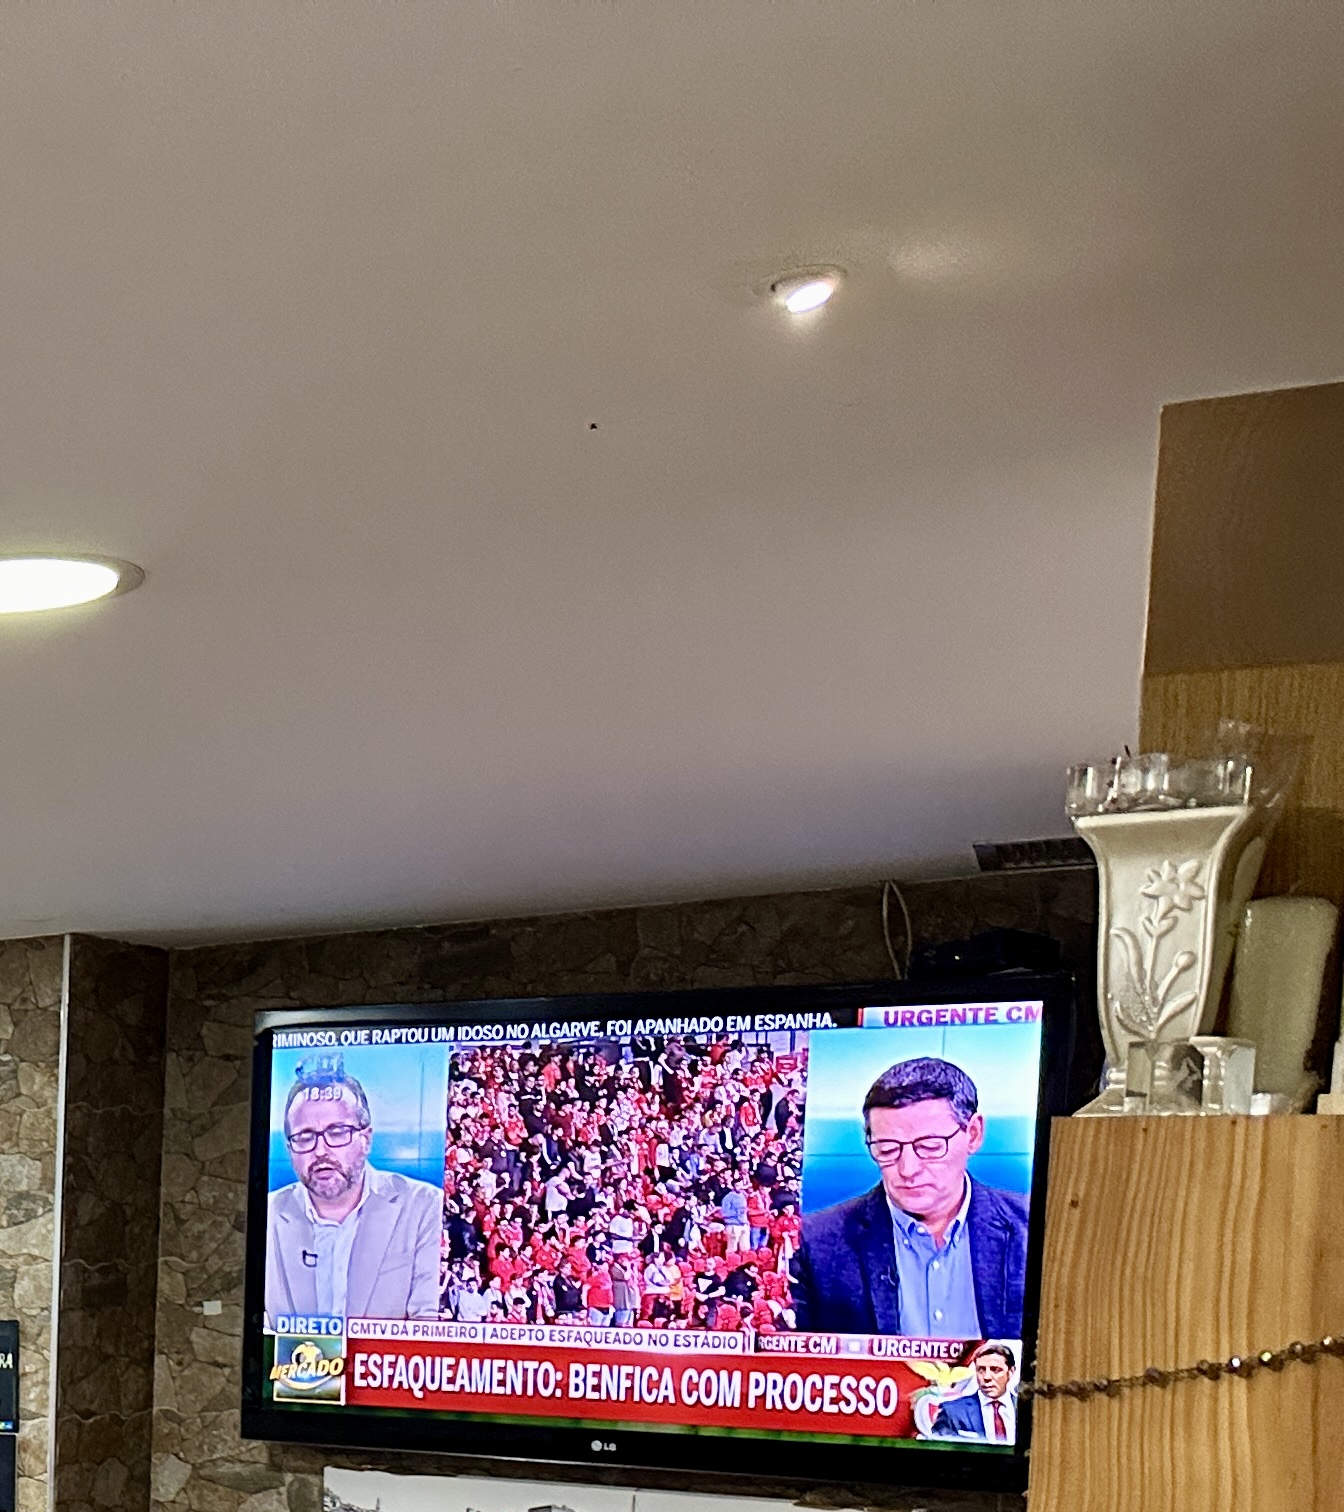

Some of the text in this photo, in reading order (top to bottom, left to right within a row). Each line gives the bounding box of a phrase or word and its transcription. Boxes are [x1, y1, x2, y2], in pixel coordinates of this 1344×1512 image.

[884, 1004, 1041, 1027] URGENTE CM
[341, 1030, 370, 1046] QUE
[372, 1027, 430, 1045] RAPTOU
[432, 1026, 455, 1042] UM
[458, 1024, 504, 1041] IDOSO
[506, 1023, 530, 1040] NO
[531, 1020, 603, 1039] ALGARVE,
[607, 1018, 633, 1036] FOI
[635, 1015, 725, 1034] APANHADO
[726, 1014, 751, 1032] EM
[754, 1012, 837, 1031] ESPANHA.
[303, 1087, 343, 1101] 18:39
[277, 1316, 342, 1335] DIRETO
[351, 1321, 388, 1336] CMTV
[413, 1324, 478, 1339] PRIMEIRO
[490, 1327, 544, 1343] ADEPTO
[548, 1329, 643, 1348] ESFAQUEADO
[647, 1333, 669, 1347] NO
[809, 1336, 837, 1355] CM
[872, 1337, 950, 1359] URGENTE
[269, 1356, 345, 1381] MERCADO
[353, 1352, 898, 1418] ESFAQUEAMENTO: BENFICA COM PROCESSO
